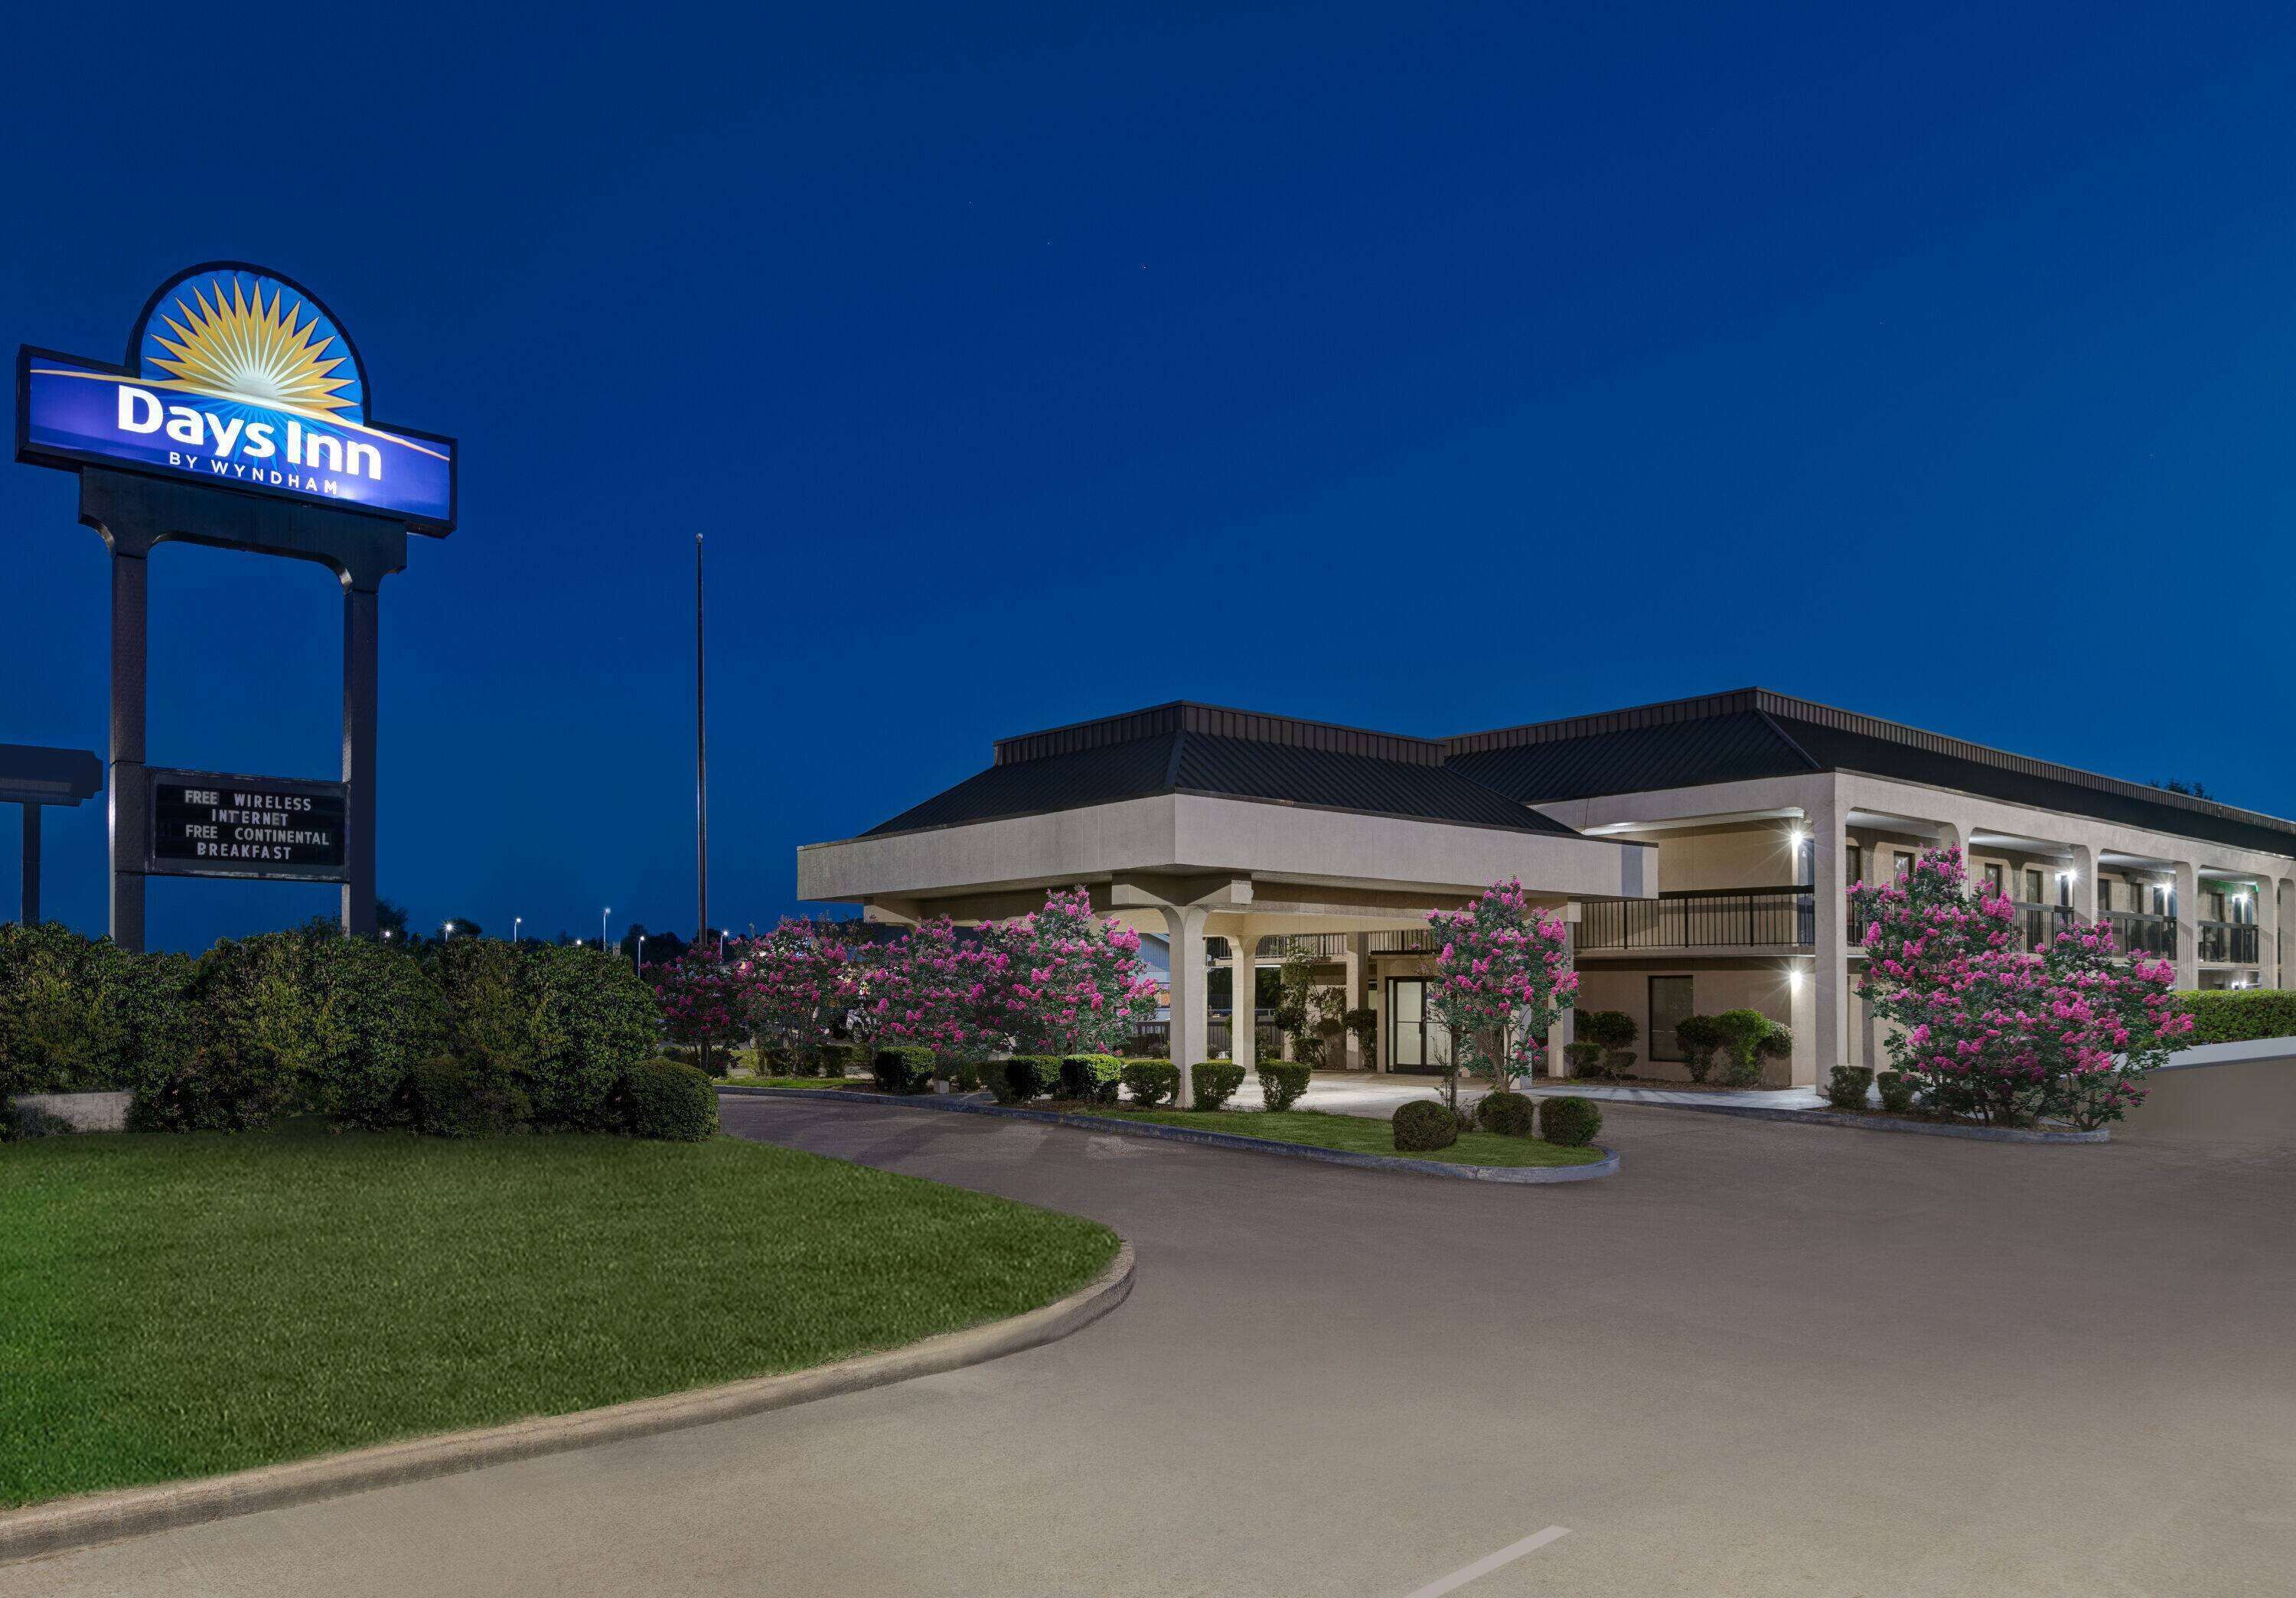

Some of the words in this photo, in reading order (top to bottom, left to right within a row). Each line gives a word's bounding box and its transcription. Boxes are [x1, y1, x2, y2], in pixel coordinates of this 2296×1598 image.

[117, 384, 276, 458] Days
[287, 420, 383, 481] Inn
[169, 451, 198, 468] BY
[210, 458, 338, 495] WYNDHAM
[184, 790, 218, 805] FREE
[233, 793, 311, 811] WIRELESS
[211, 808, 289, 827] INTERNET
[185, 824, 218, 840] FREE
[234, 827, 329, 846] CONTINENTAL
[197, 842, 291, 860] BREAKFAST
